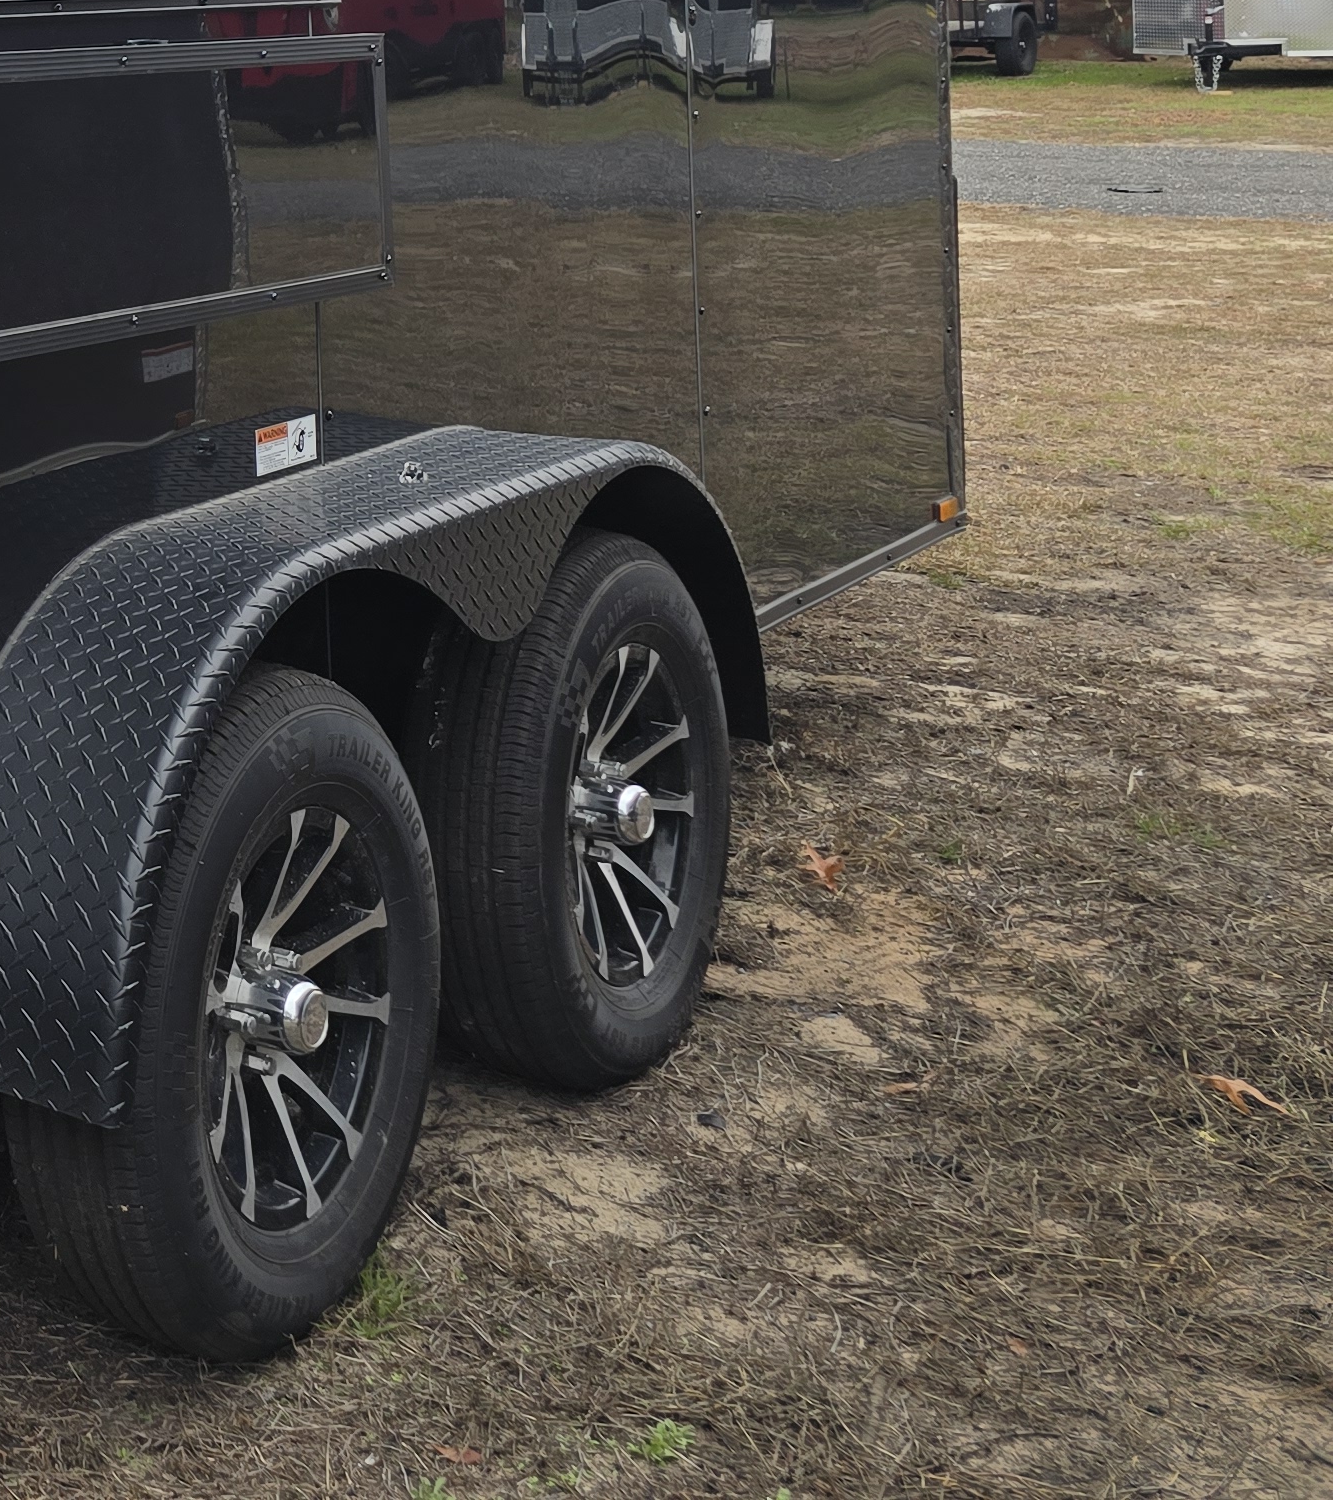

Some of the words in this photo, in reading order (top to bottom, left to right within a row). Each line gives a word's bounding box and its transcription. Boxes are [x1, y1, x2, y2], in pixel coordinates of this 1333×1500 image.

[263, 425, 287, 440] WARNING
[327, 732, 394, 784] TRAILER
[391, 775, 422, 841] KING
[417, 851, 437, 901] RST
